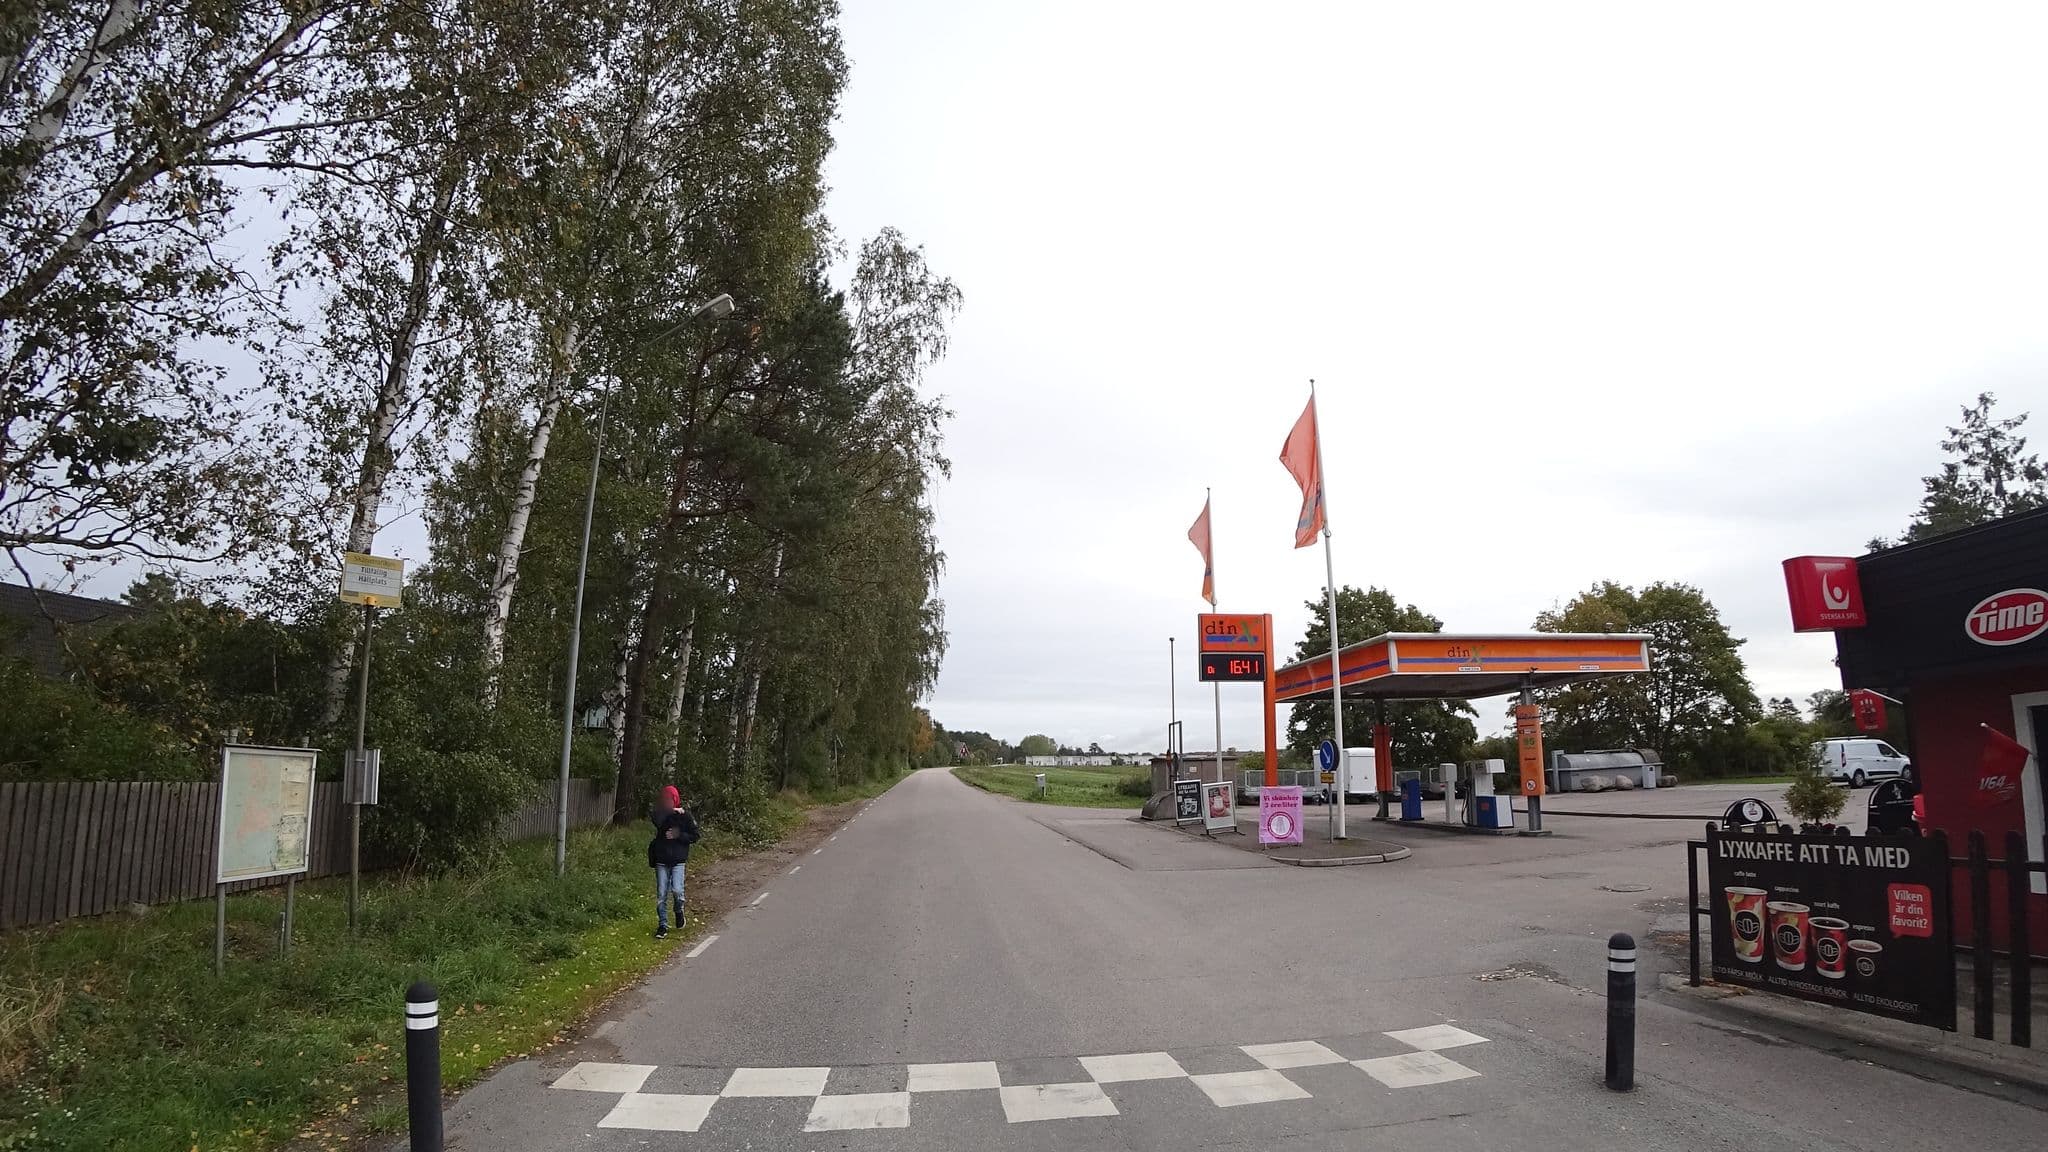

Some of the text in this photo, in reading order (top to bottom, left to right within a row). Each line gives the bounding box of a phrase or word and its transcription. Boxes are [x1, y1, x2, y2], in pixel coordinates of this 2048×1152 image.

[358, 575, 387, 586] Hållplats
[1820, 612, 1846, 621] SVENSKA
[1971, 601, 2045, 635] Time
[1979, 775, 2006, 790] V64
[1719, 839, 1911, 869] LYXKAFFE ATT TA MED
[1893, 889, 1923, 902] Vilken
[1895, 902, 1924, 915] är din
[1892, 914, 1928, 929] favorit?
[1768, 975, 1787, 986] ALLTID
[1854, 992, 1875, 1004] ALLTID
